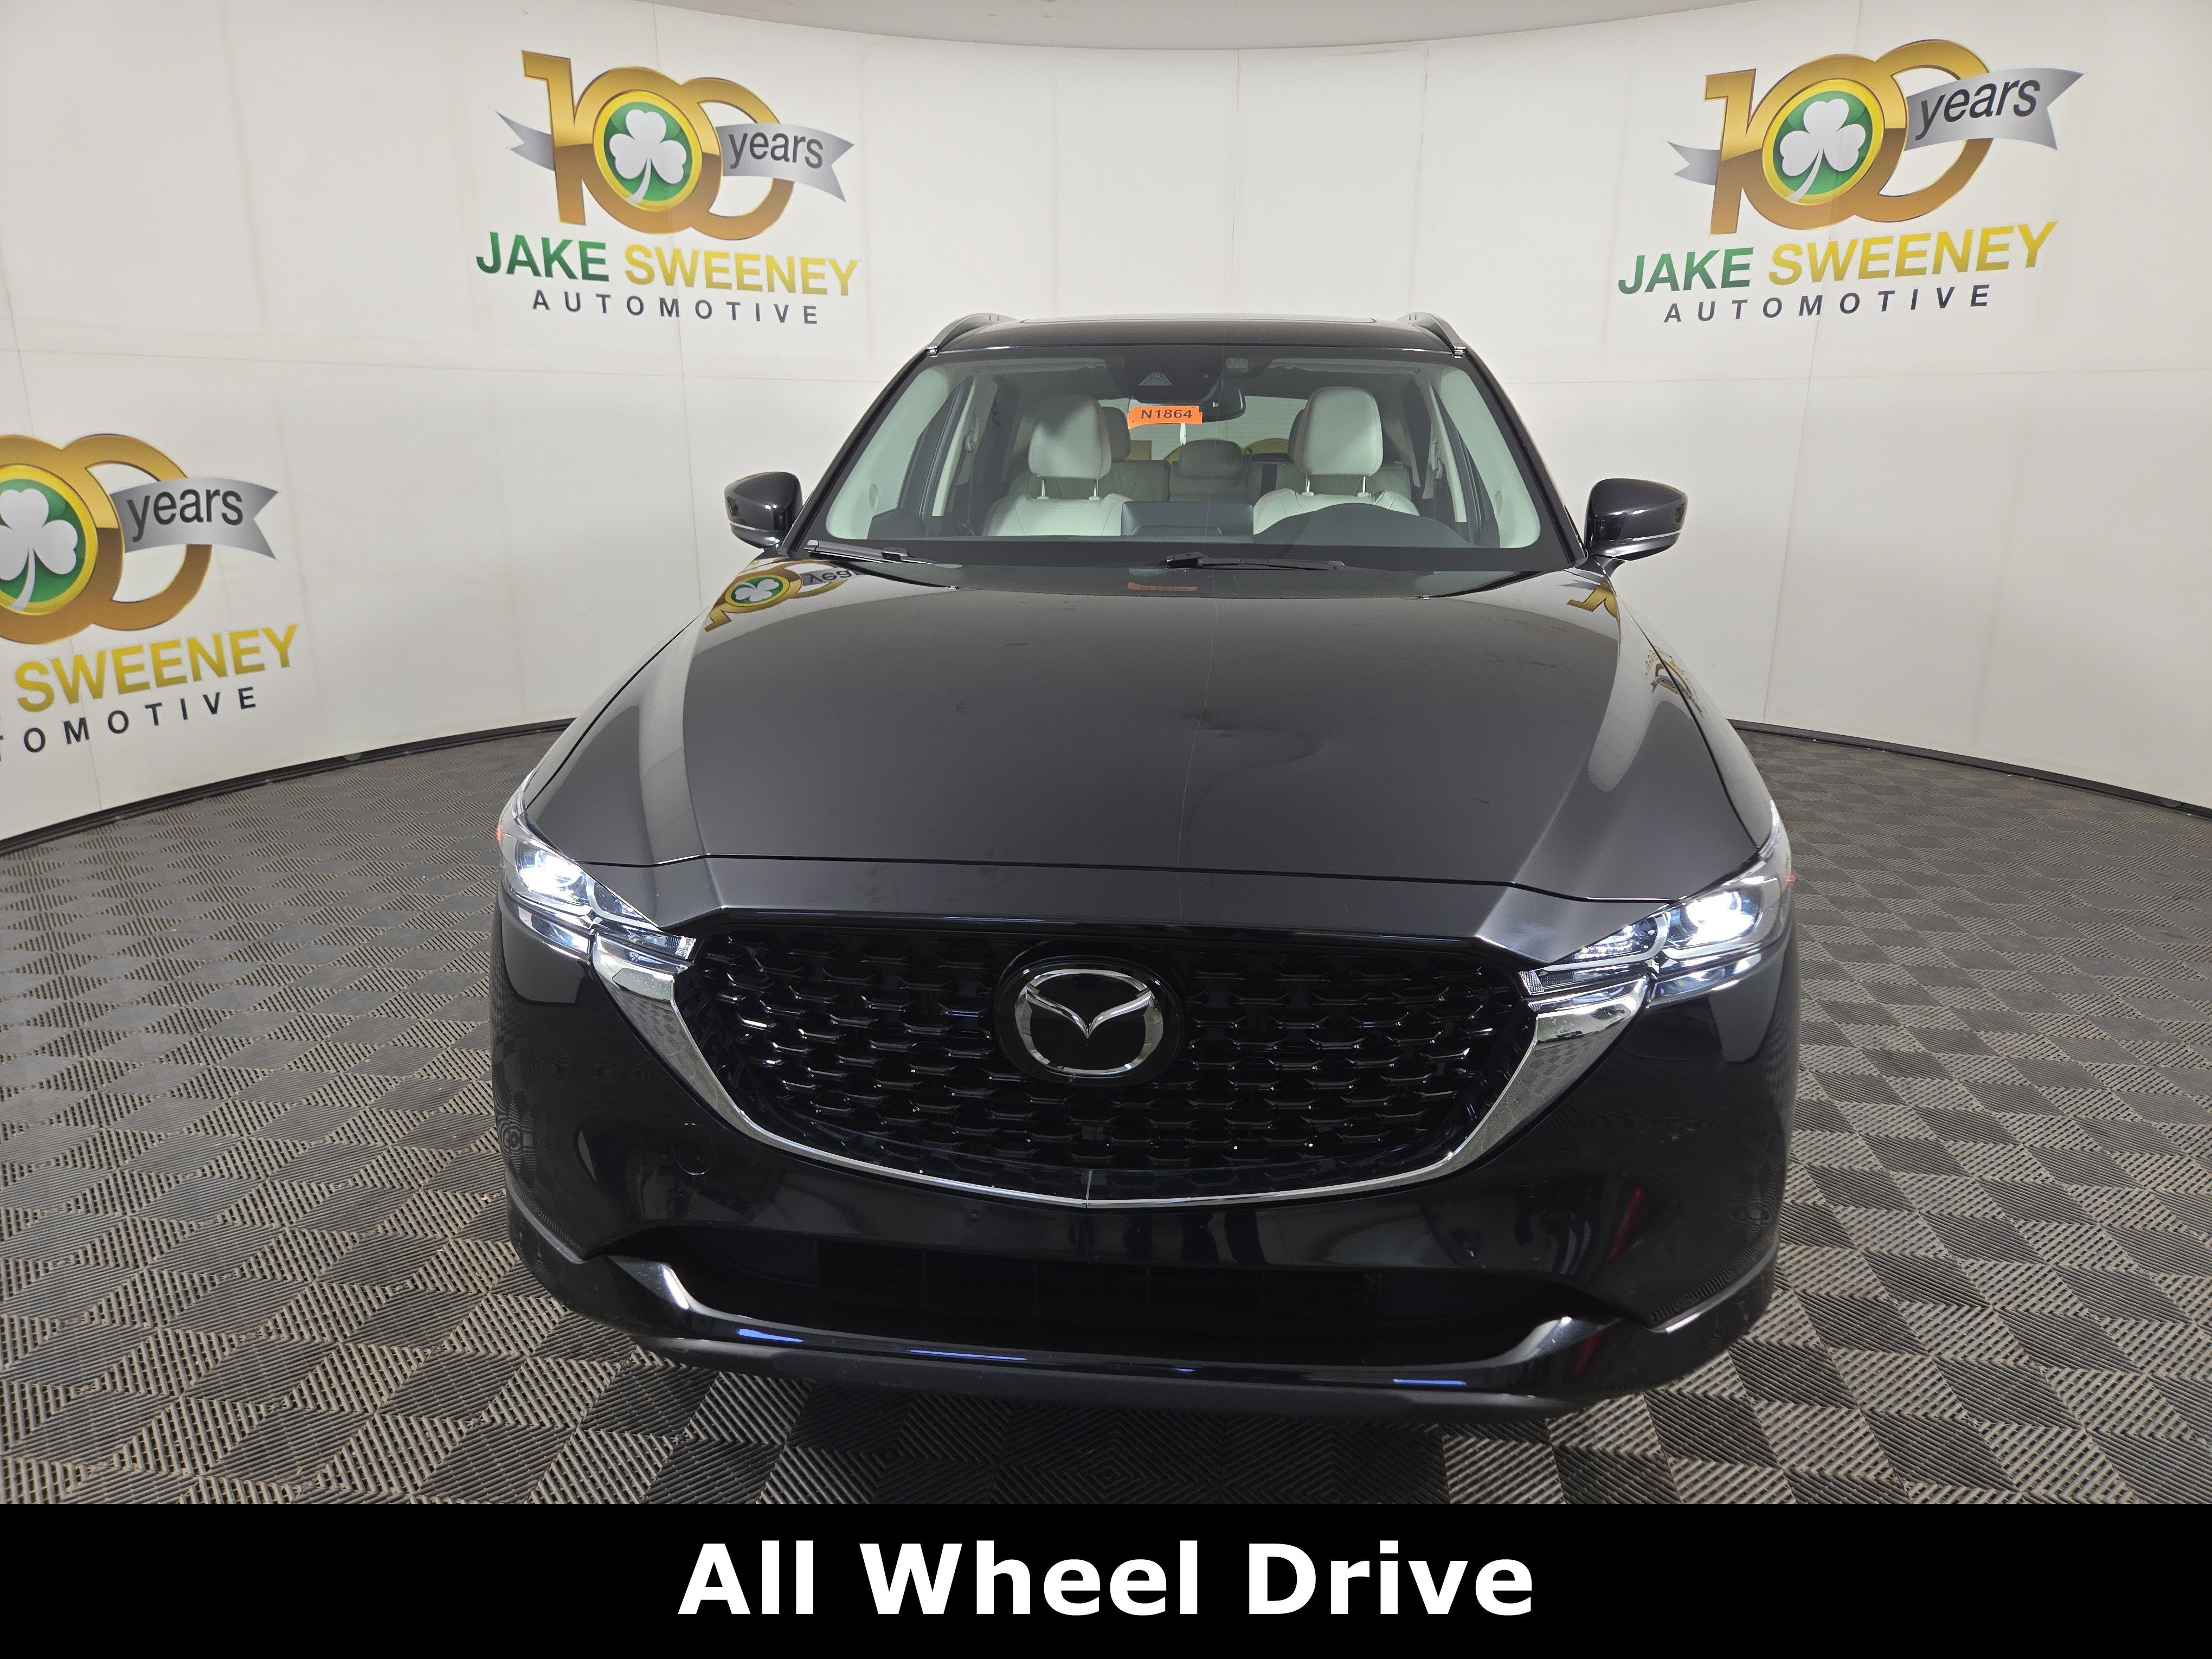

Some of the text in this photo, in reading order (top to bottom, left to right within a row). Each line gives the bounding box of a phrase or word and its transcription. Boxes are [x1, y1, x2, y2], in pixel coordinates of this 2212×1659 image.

[522, 50, 824, 240] 100 years
[1705, 39, 2041, 236] 100 years
[476, 232, 859, 296] JAKE SWEENEY
[1618, 221, 2059, 294] JAKE SWEENEY
[532, 290, 818, 324] AUTOMOTIVE
[1664, 284, 1990, 323] AUTOMOTIVE
[1141, 409, 1192, 419] N1864
[127, 488, 243, 542] years
[15, 625, 298, 713] SWEENEY
[0, 687, 256, 761] OMOTIVE
